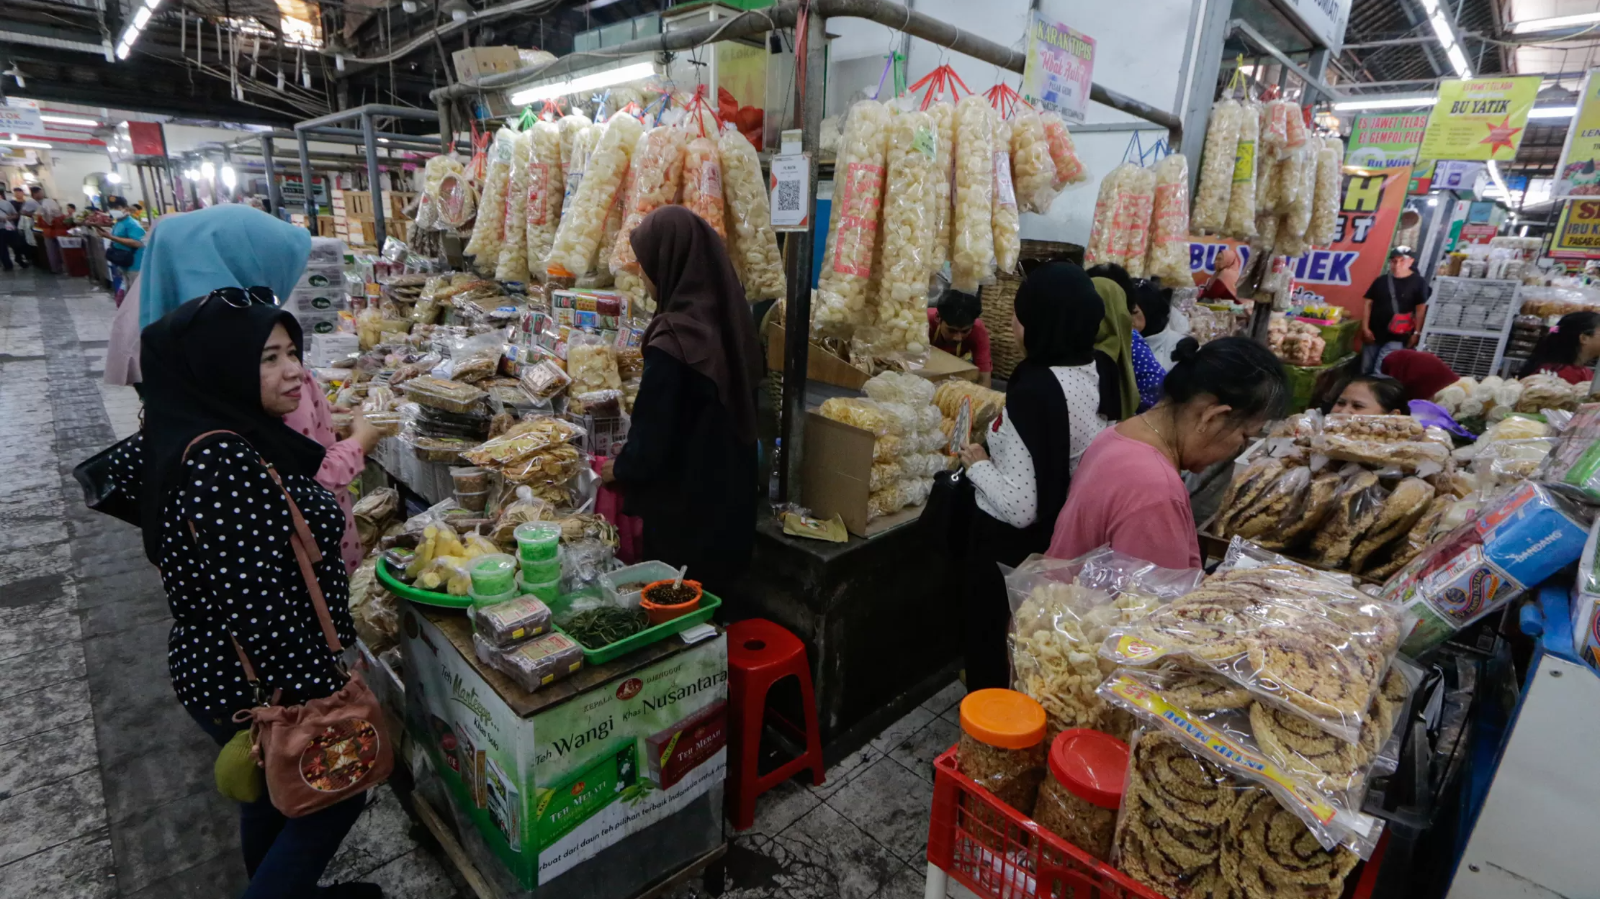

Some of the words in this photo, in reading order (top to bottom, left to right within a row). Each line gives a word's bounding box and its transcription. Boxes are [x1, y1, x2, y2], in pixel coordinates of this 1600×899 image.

[1037, 19, 1069, 52] KARAK
[1069, 36, 1093, 61] TIPIS
[1450, 100, 1471, 114] BU
[1472, 99, 1512, 114] YATIK
[1358, 118, 1368, 129] ES
[1358, 131, 1368, 144] ES
[535, 751, 552, 766] Teh
[552, 715, 614, 757] Wangi
[622, 709, 642, 722] Khas
[643, 670, 728, 715] Nusantara
[563, 844, 579, 858] dari
[580, 833, 600, 848] daun
[601, 824, 614, 836] teh
[614, 812, 640, 830] pilihan
[642, 798, 668, 816] terbaik
[668, 780, 698, 803] Indonesia
